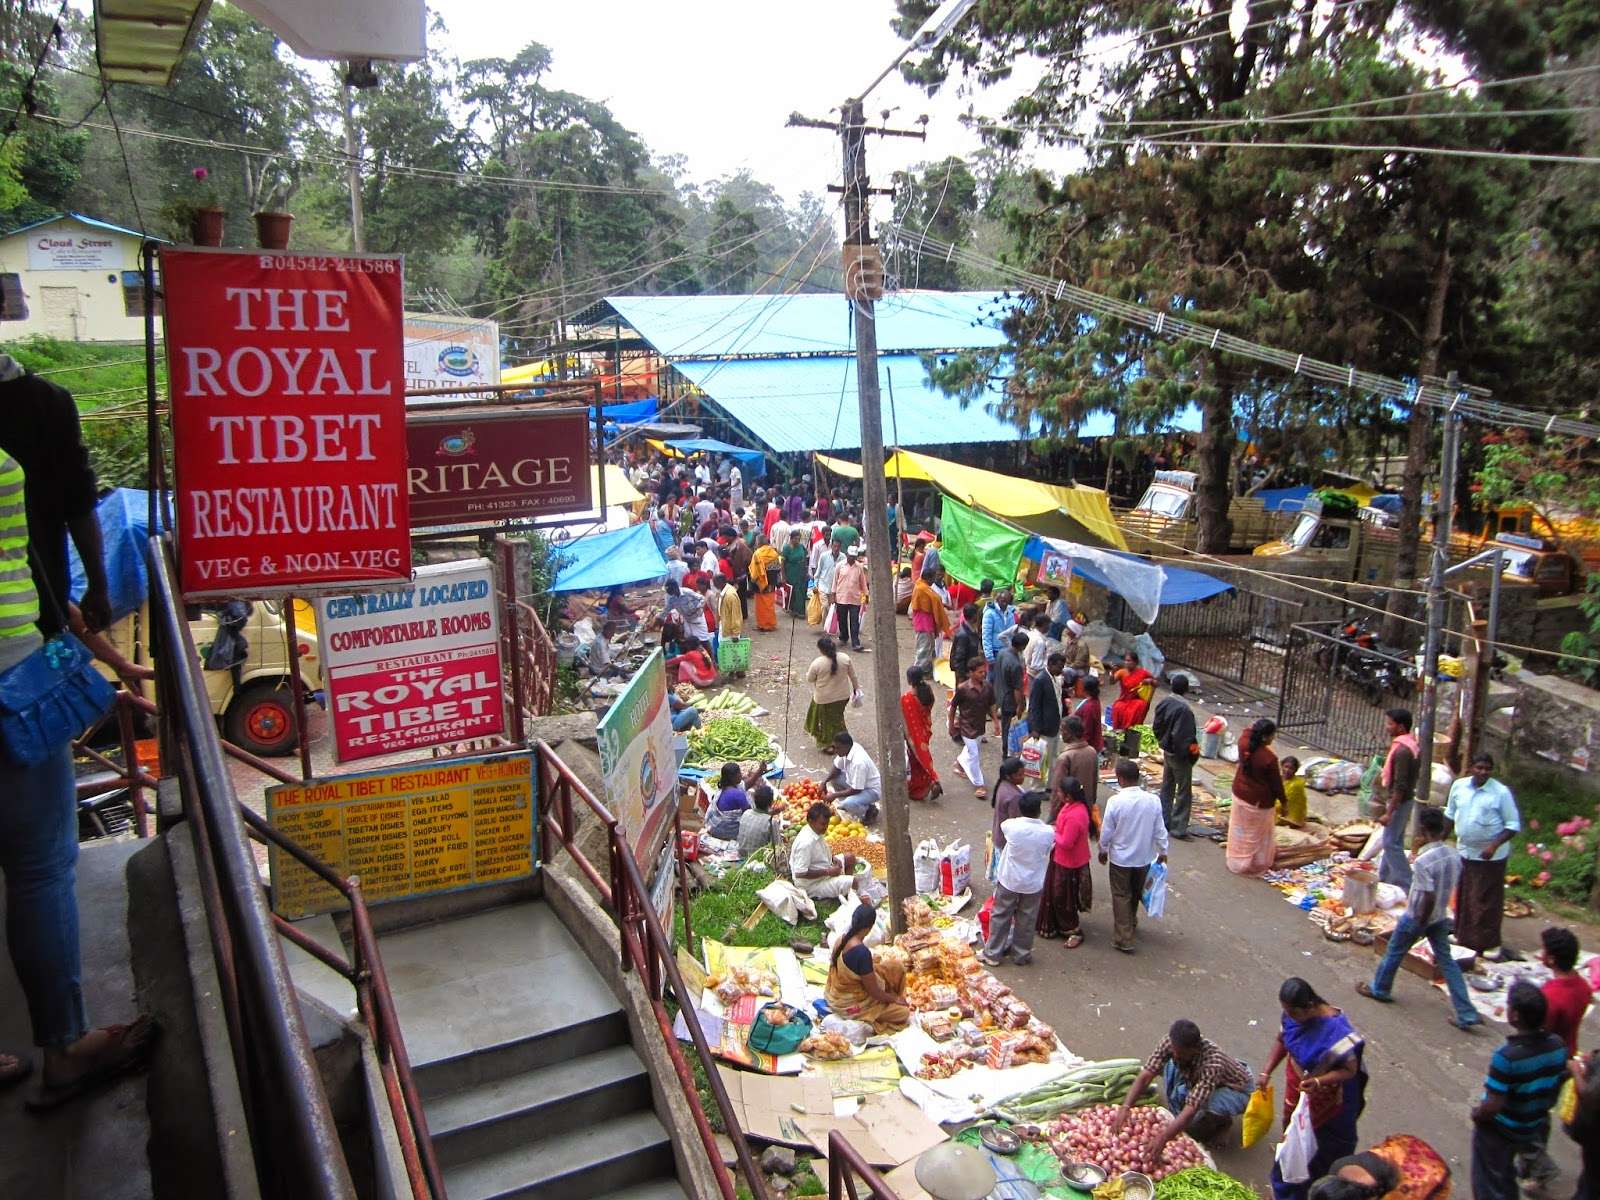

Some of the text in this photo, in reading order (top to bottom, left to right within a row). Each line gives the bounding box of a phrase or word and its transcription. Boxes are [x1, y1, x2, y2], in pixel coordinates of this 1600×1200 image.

[38, 238, 73, 250] Cloud
[226, 288, 350, 332] THE
[181, 346, 392, 397] ROYAL
[208, 414, 382, 464] TIBET
[407, 457, 573, 495] RITAGE
[190, 483, 399, 539] RESTAURANT
[521, 498, 540, 507] FAX
[195, 549, 401, 579] VEG & NON-VEG
[326, 579, 489, 620] CENTRALLY LOCATED
[330, 611, 492, 652] COMFORTABLE ROOMS
[376, 651, 453, 671] RESTAURANT
[390, 666, 444, 682] THE
[336, 671, 498, 712] ROYAL
[348, 696, 492, 734] TIBET
[349, 714, 494, 747] RESTAURANT
[441, 730, 465, 738] VEG
[277, 790, 299, 805] THE
[304, 785, 342, 802] ROYAL
[347, 780, 385, 796] TIBET
[391, 769, 471, 790] RESTAURANT
